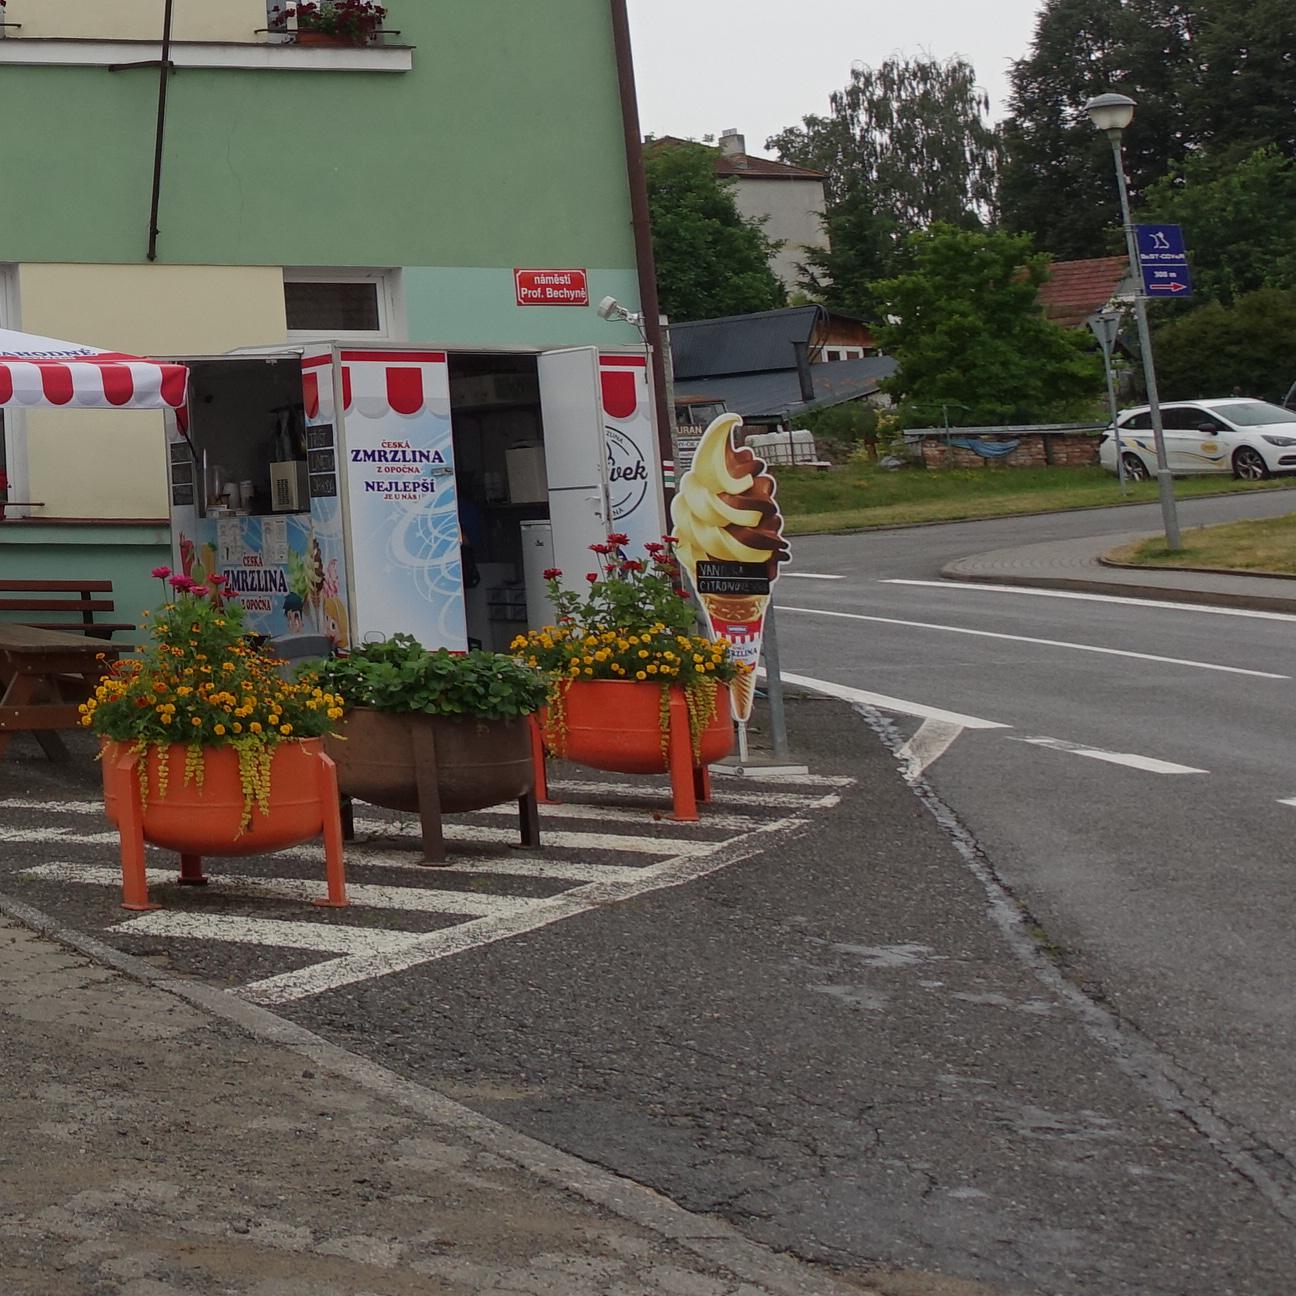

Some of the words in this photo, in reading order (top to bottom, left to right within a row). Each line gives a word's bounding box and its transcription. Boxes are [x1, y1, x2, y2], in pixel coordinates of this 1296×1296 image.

[534, 273, 571, 285] náměstí
[520, 287, 544, 298] Prof.
[546, 287, 586, 301] Bechyně
[381, 440, 411, 449] ČESKÁ
[350, 449, 445, 464] ZMRZLINA
[384, 465, 421, 474] OPOČNA
[364, 478, 435, 493] NEJLEPŠÍ
[242, 552, 264, 567] ČESKÁ
[223, 570, 288, 593] ZMRZLINA
